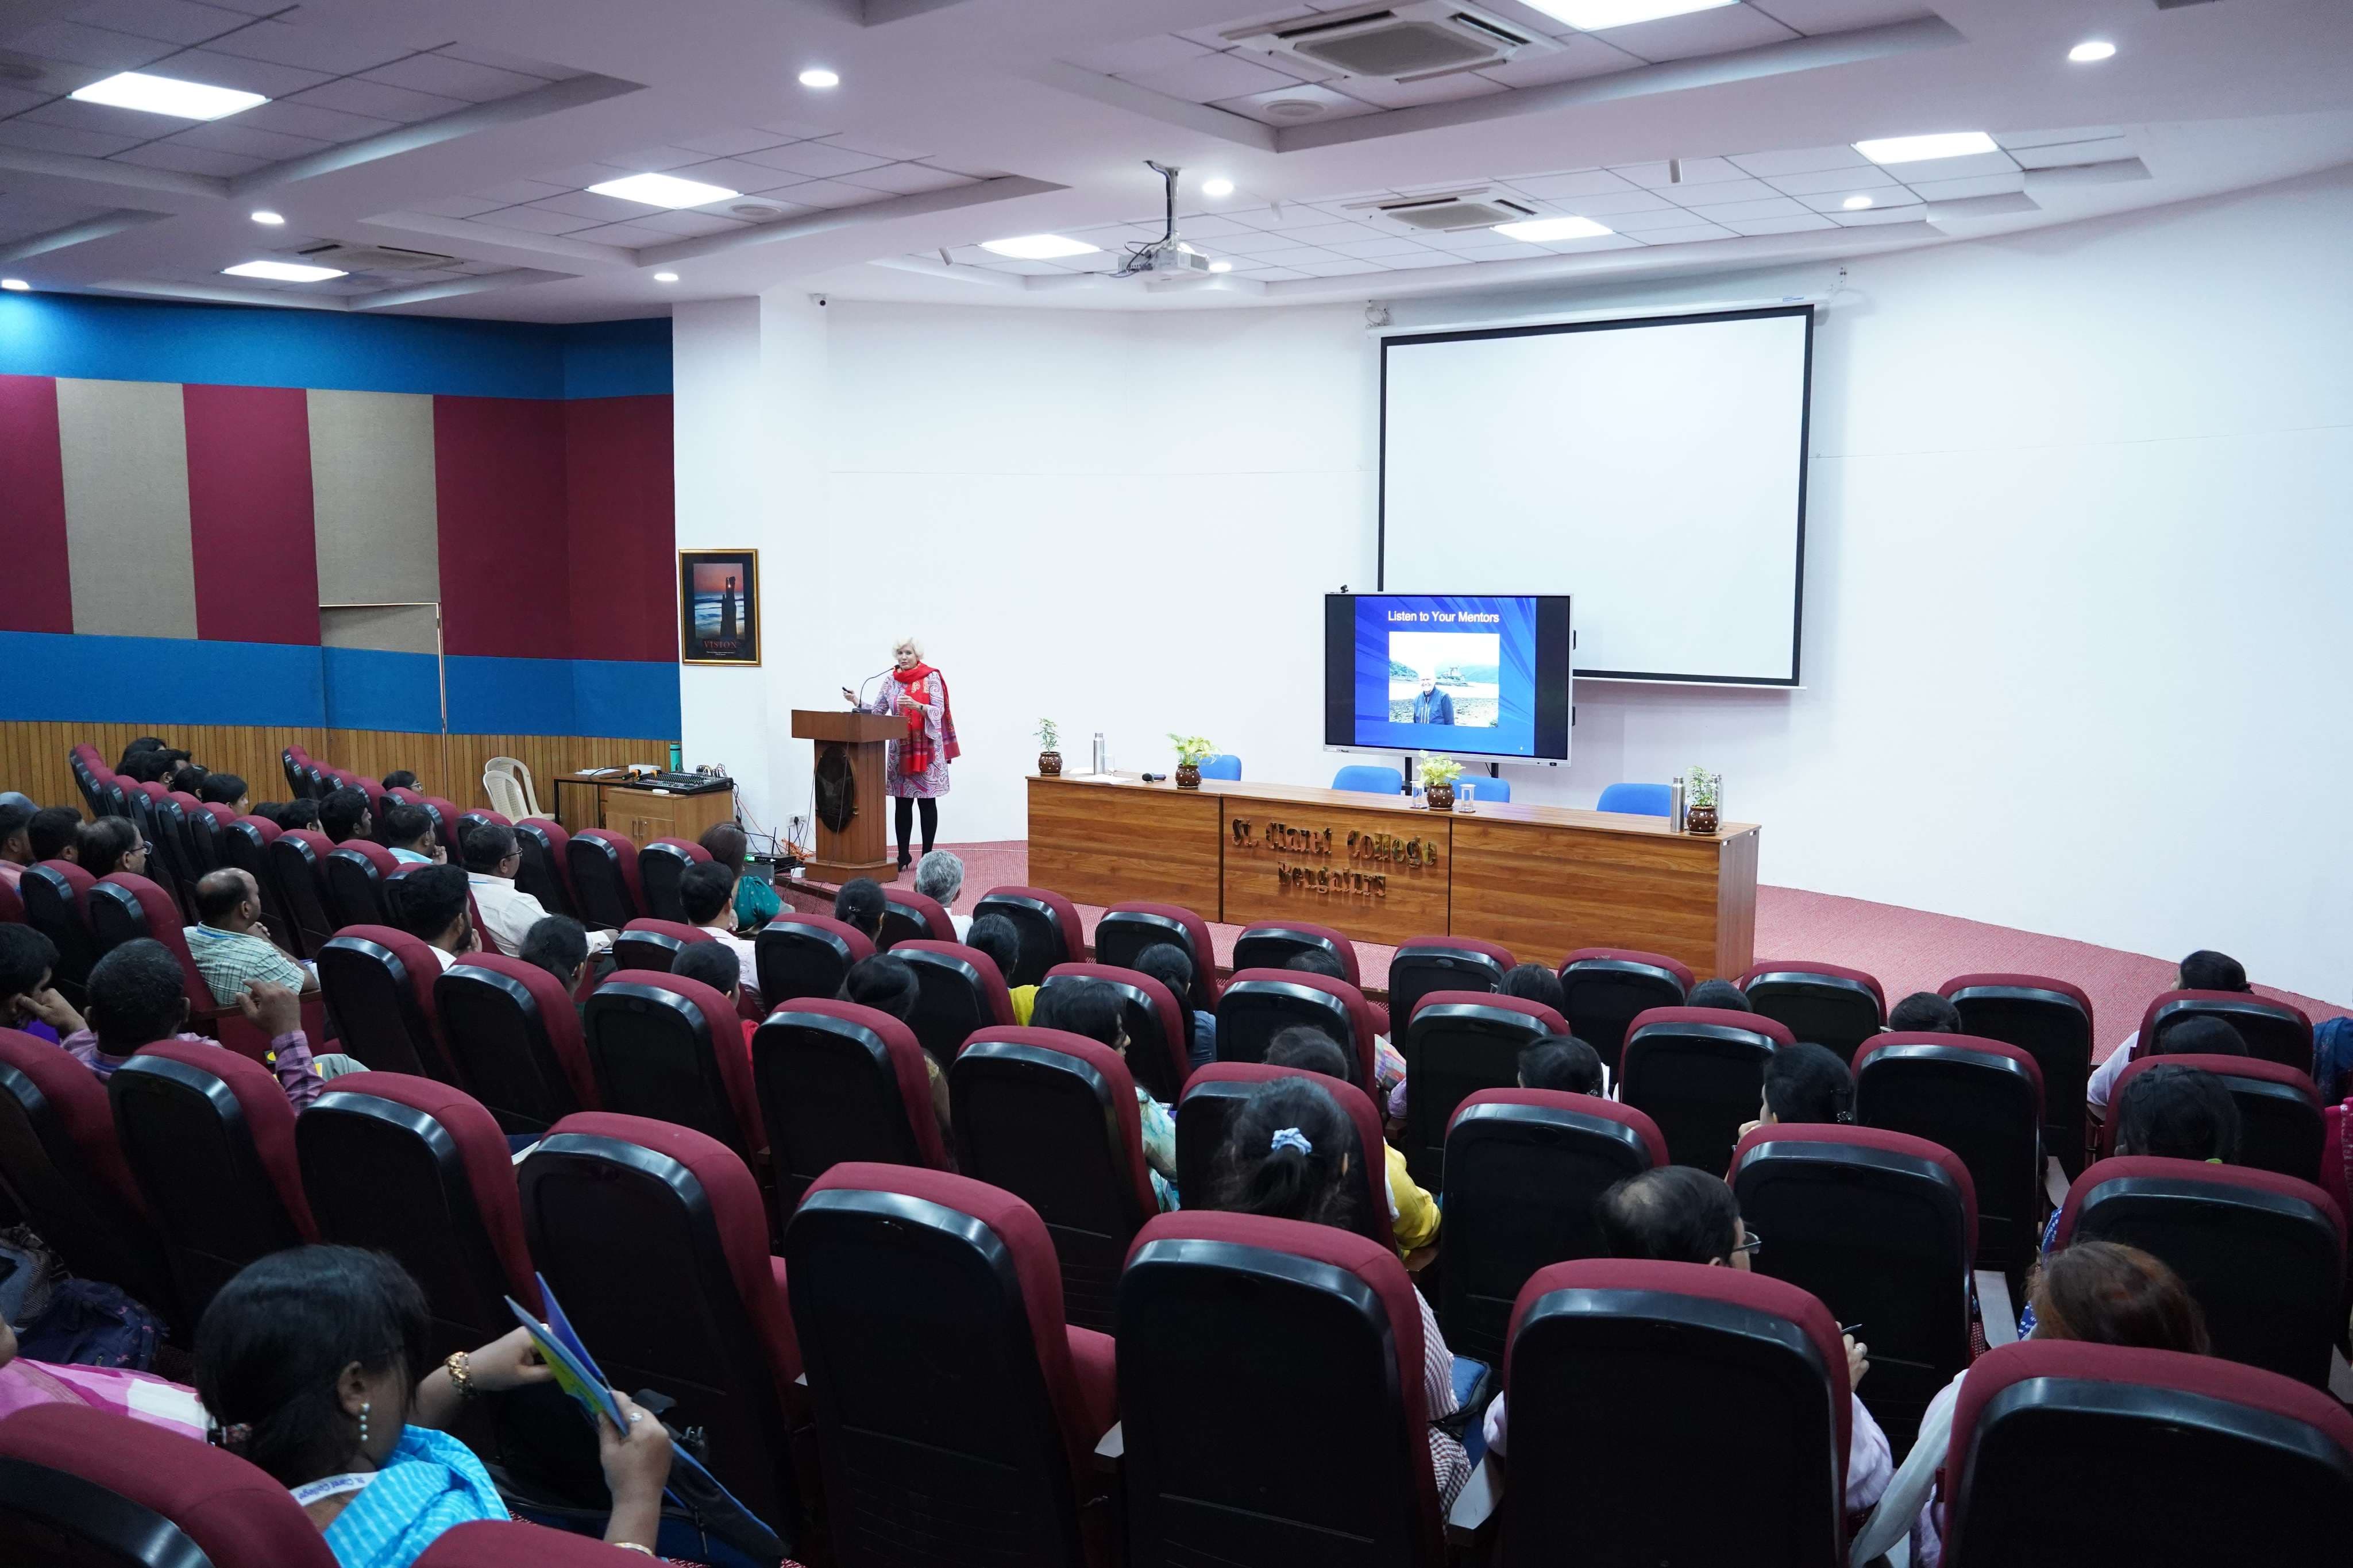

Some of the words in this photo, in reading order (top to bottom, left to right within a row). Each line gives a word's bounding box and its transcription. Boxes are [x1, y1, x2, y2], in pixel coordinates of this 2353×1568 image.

[1388, 611, 1417, 621] Listen
[1419, 611, 1429, 621] to
[1432, 611, 1456, 622] Your
[1458, 611, 1500, 623] Mentors
[704, 640, 737, 648] VISION
[1232, 818, 1259, 847] St.
[1266, 821, 1333, 855] Claret
[1347, 830, 1438, 868] College
[1278, 862, 1387, 897] Bengaluru
